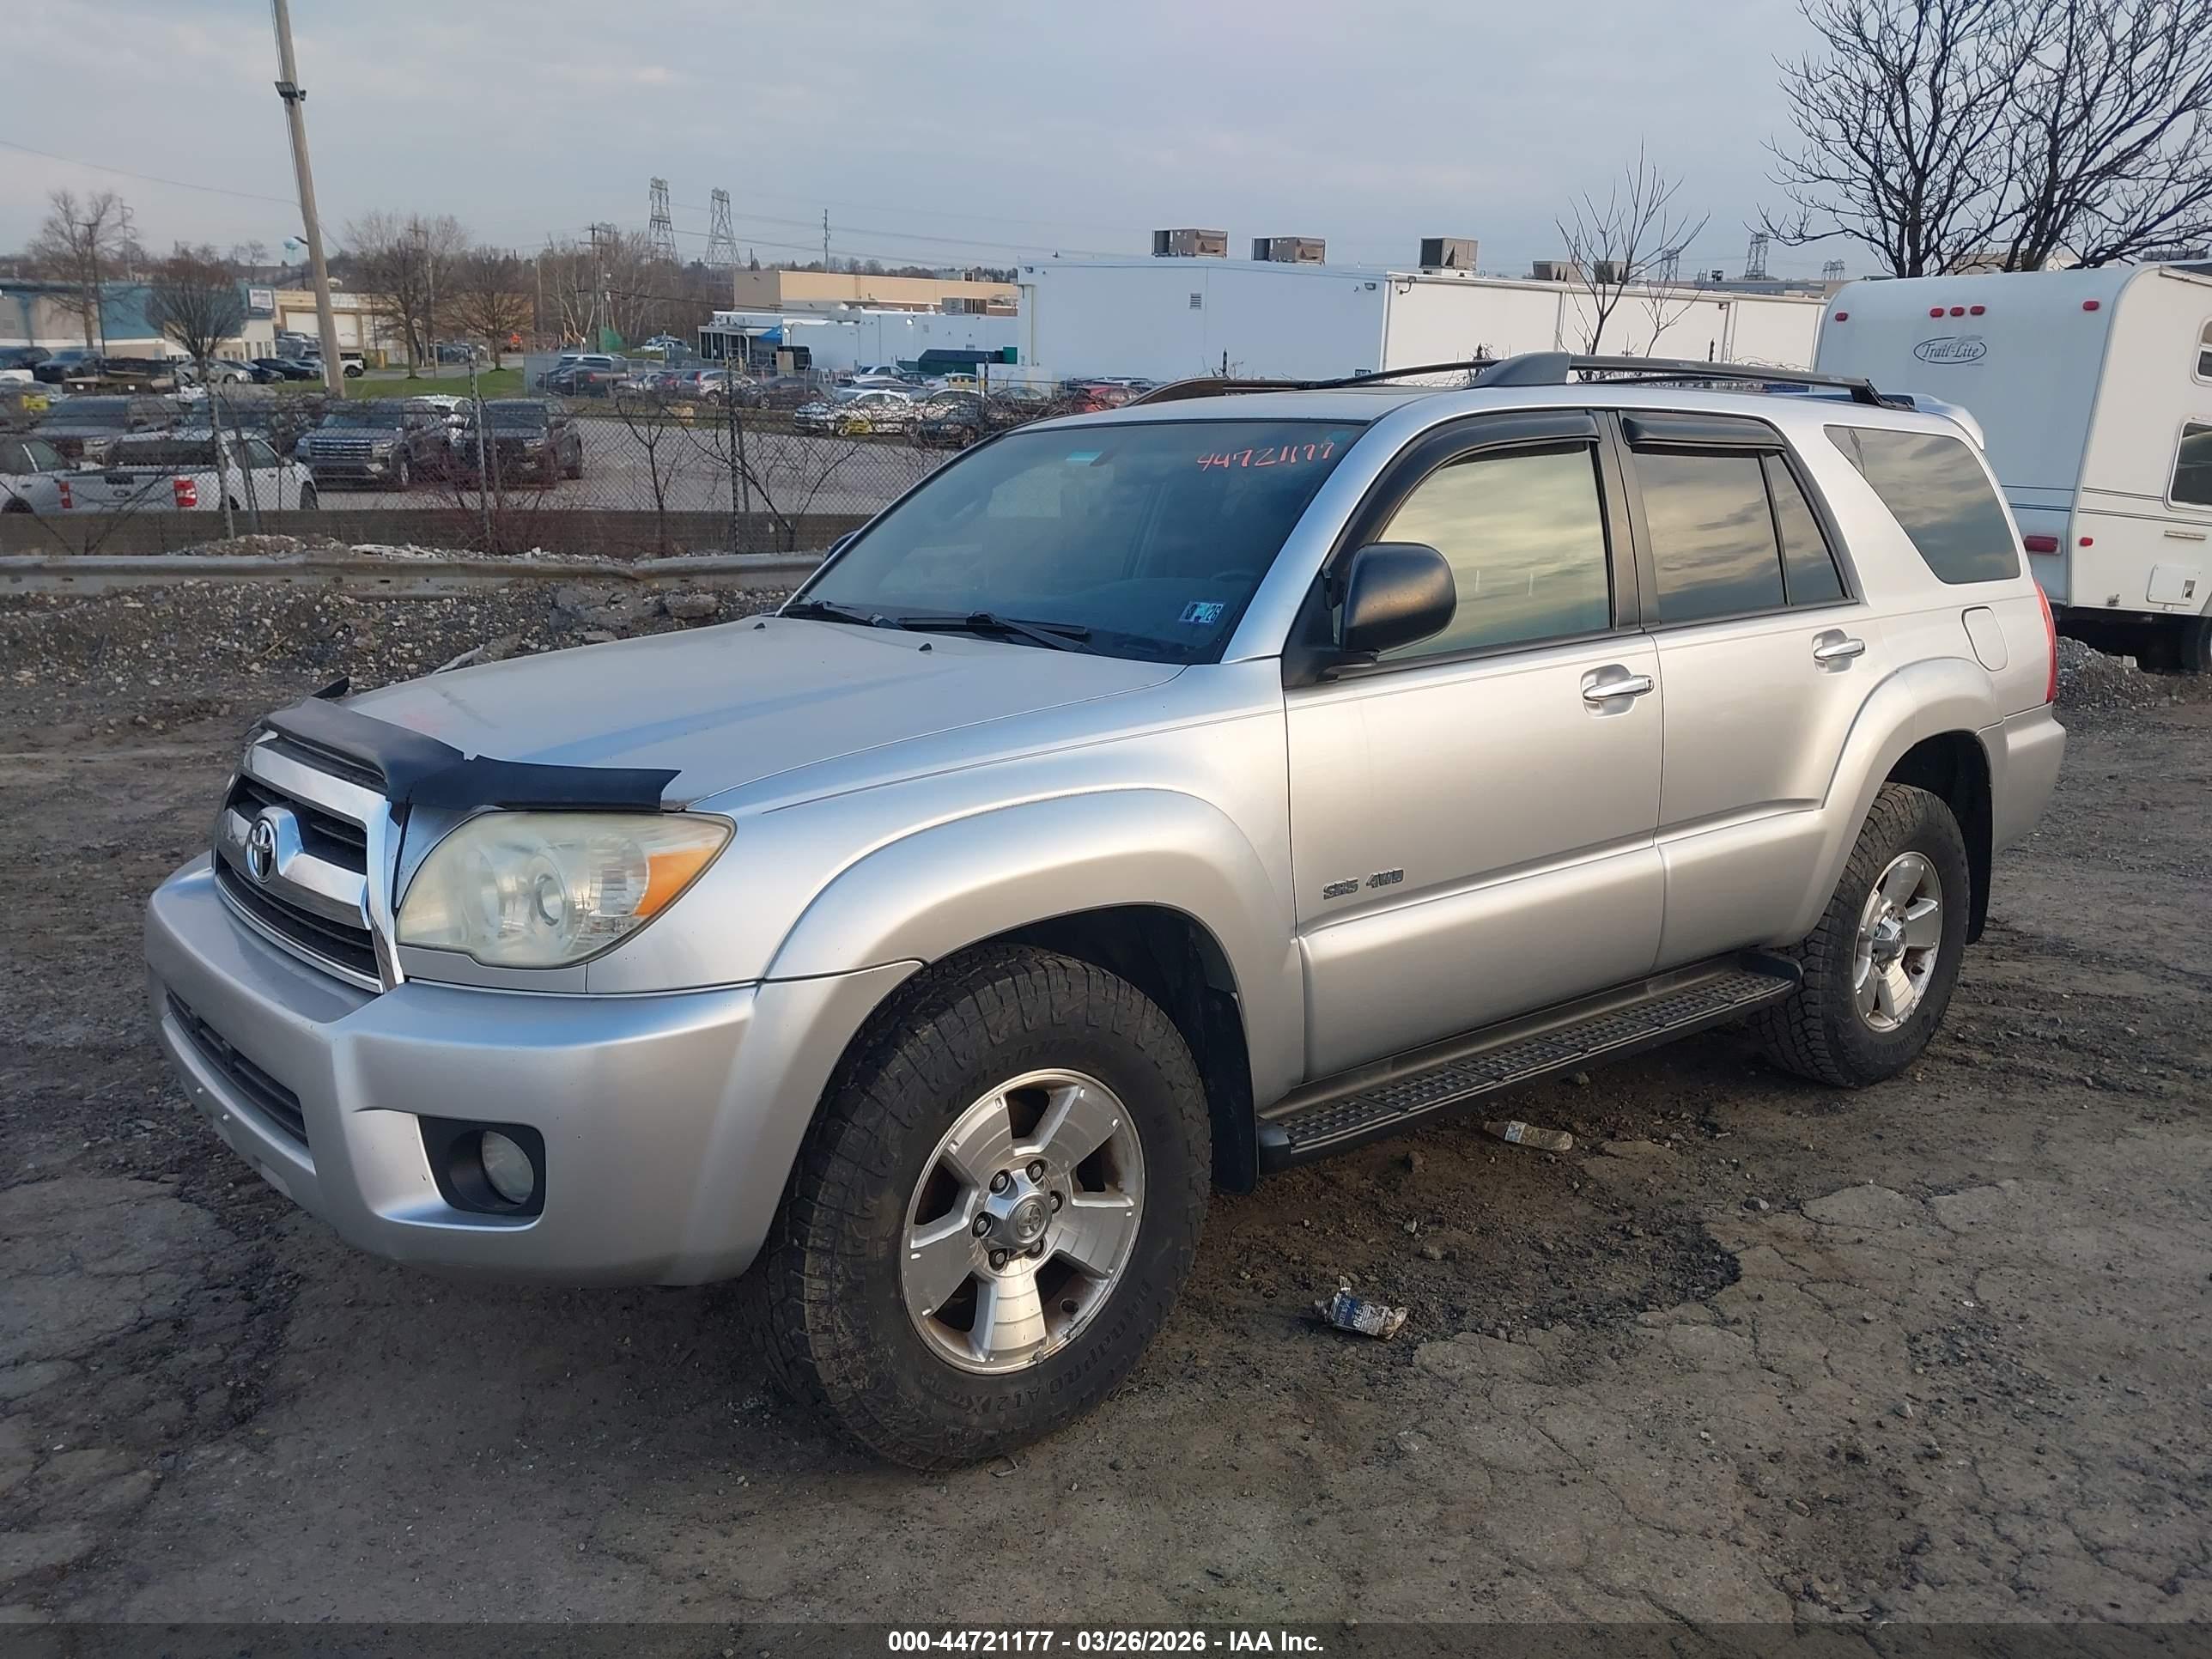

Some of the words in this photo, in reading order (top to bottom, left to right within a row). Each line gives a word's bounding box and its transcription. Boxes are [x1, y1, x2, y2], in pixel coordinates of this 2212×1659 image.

[1922, 343, 1979, 358] Trail-Lite
[1197, 441, 1334, 471] 44721177
[1323, 878, 1358, 900] SR5
[1366, 868, 1404, 889] 4WD
